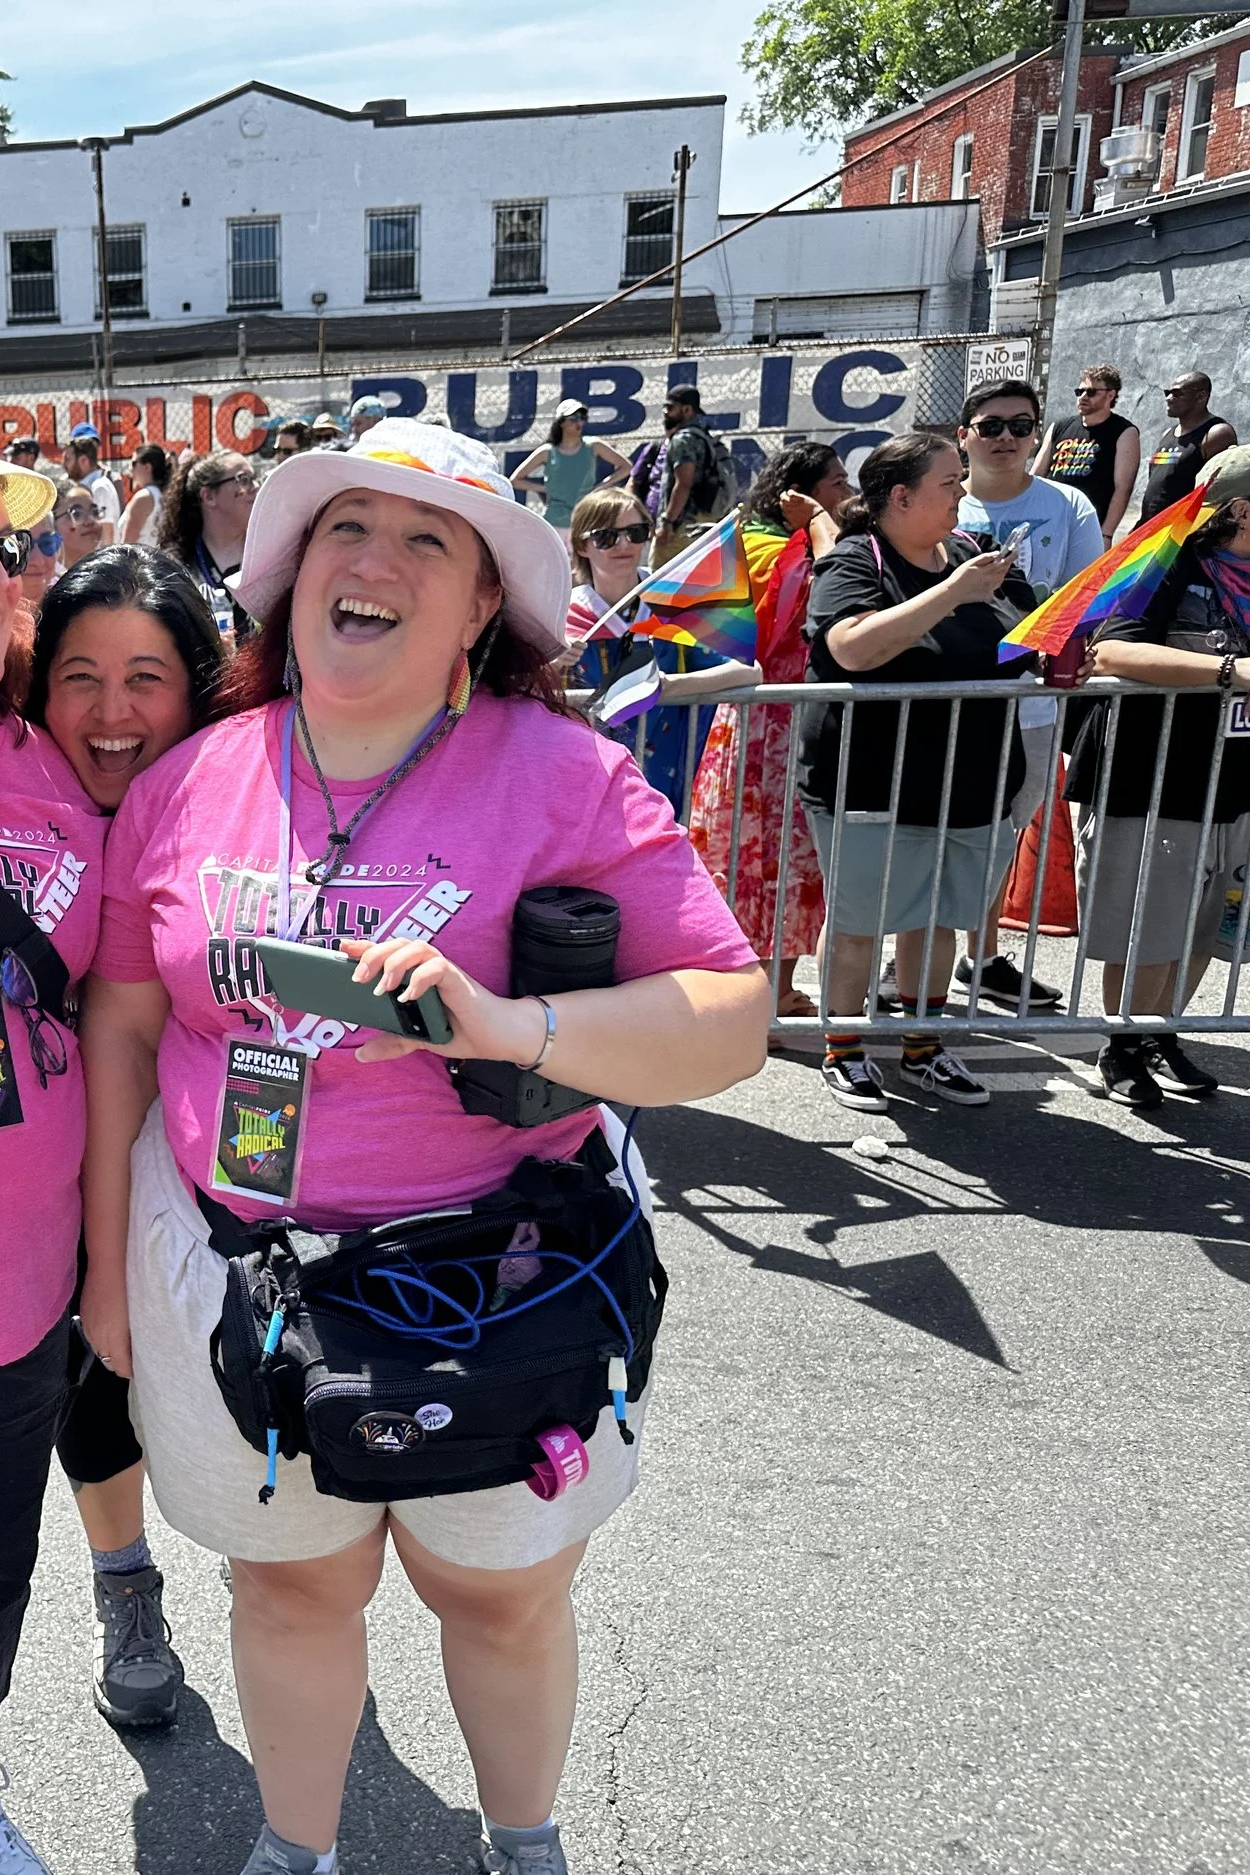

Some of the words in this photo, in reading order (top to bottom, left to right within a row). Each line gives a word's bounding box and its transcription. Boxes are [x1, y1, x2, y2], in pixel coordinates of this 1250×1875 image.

[986, 350, 1010, 365] NO
[970, 364, 1024, 382] PARKING
[352, 350, 908, 445] PUBLIC
[1056, 438, 1100, 453] Pride
[1050, 461, 1092, 477] Pride
[233, 1048, 299, 1072] OFFICIAL
[232, 1061, 299, 1081] PHOTOGRAPHER
[238, 1108, 285, 1137] TOTALLY
[236, 1134, 286, 1159] RADICAL
[422, 1410, 441, 1420] She
[424, 1419, 445, 1428] Her
